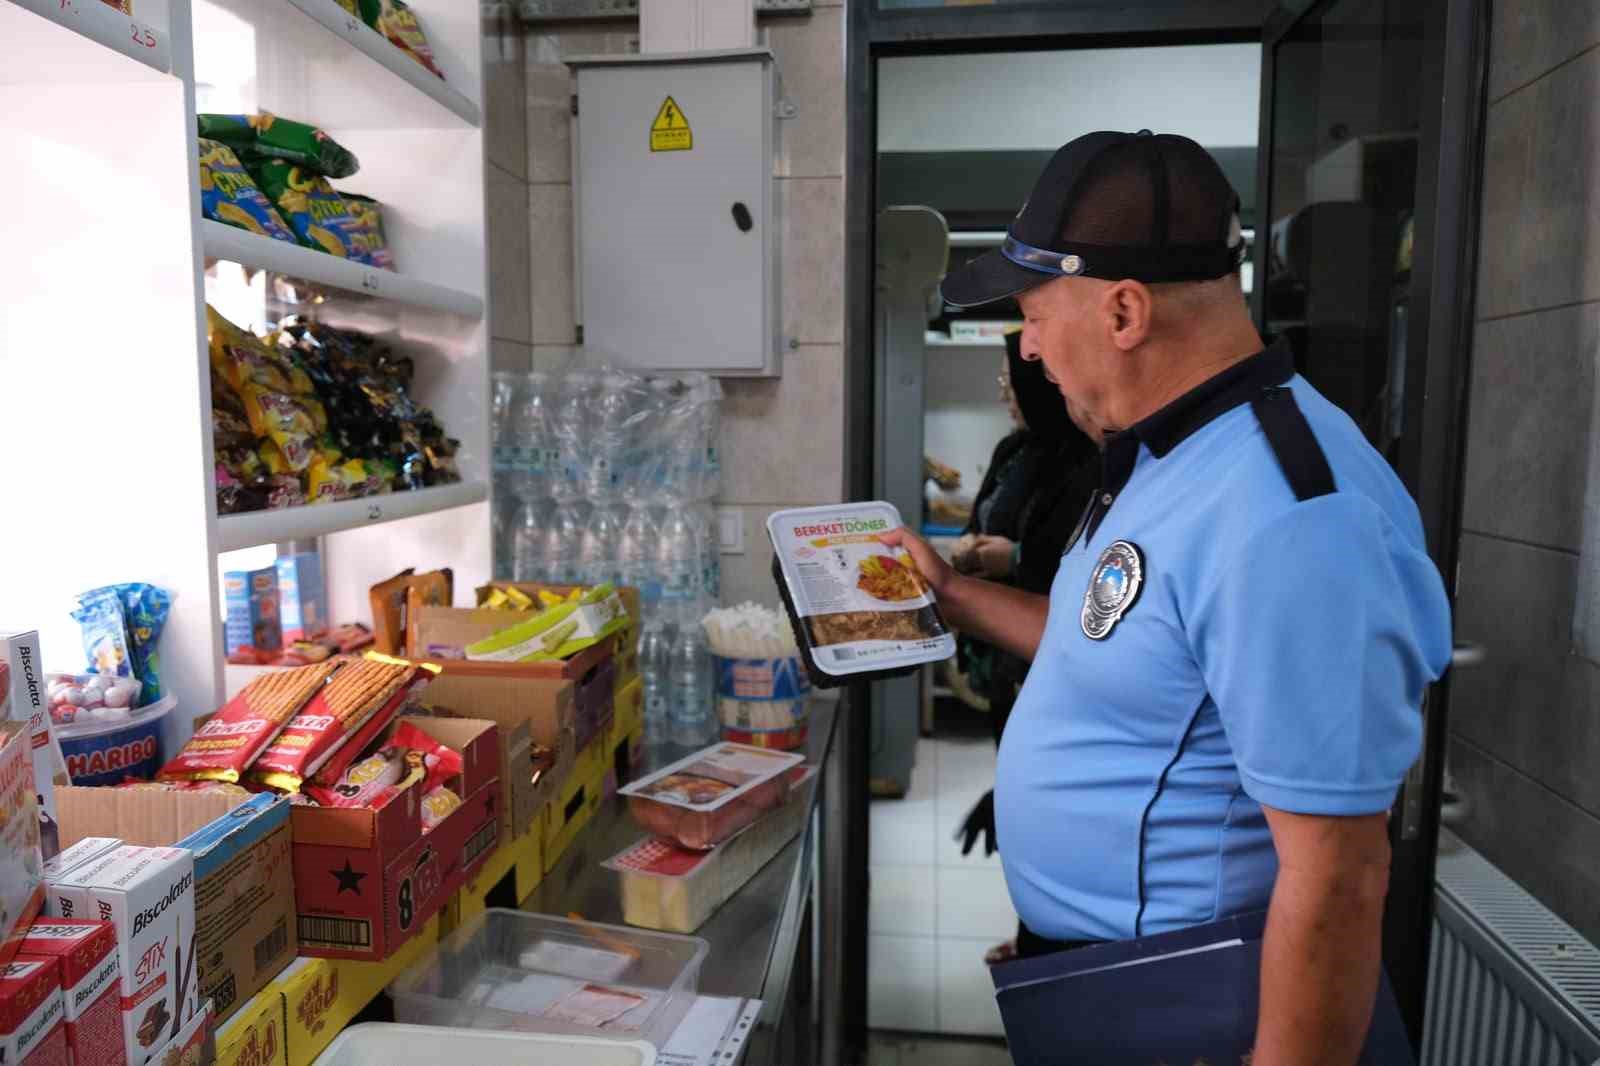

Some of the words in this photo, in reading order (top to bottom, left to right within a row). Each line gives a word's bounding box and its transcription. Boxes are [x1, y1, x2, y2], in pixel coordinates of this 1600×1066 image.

[130, 24, 156, 47] 25
[18, 646, 40, 707] Biscolata
[66, 737, 157, 777] HARIBO
[131, 870, 192, 938] Biscolata
